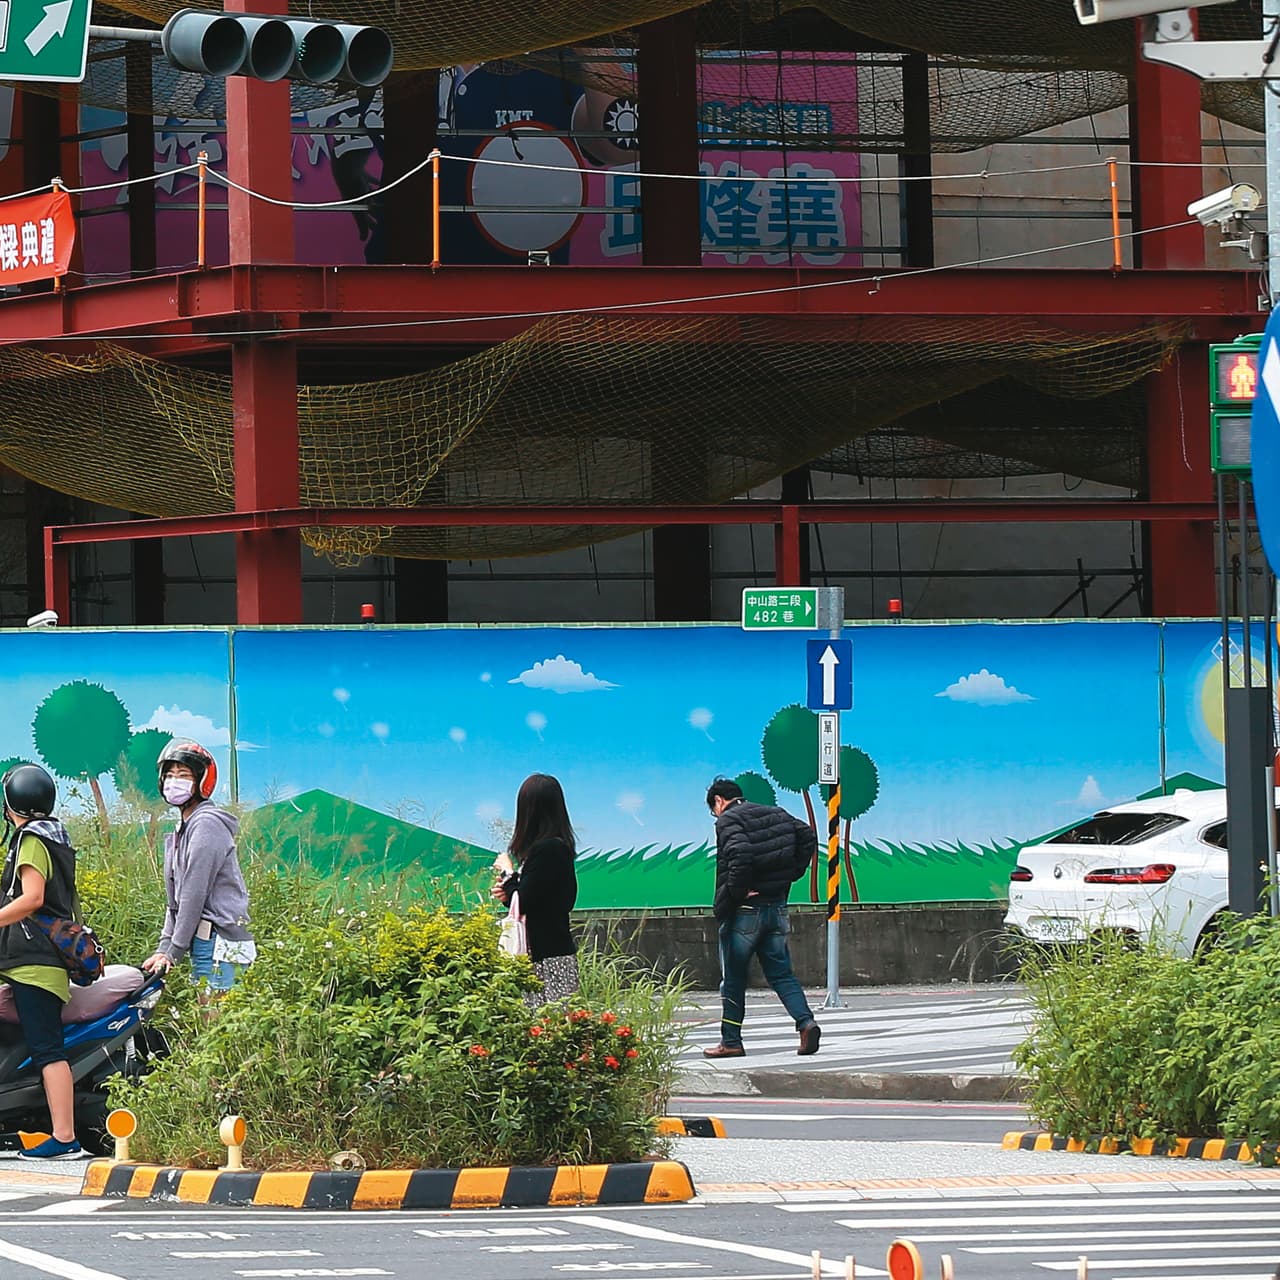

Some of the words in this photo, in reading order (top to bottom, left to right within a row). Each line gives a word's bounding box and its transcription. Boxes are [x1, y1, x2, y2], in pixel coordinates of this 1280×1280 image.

[747, 595, 801, 607] 中山路二段
[753, 611, 778, 623] 482
[782, 611, 795, 623] 巷
